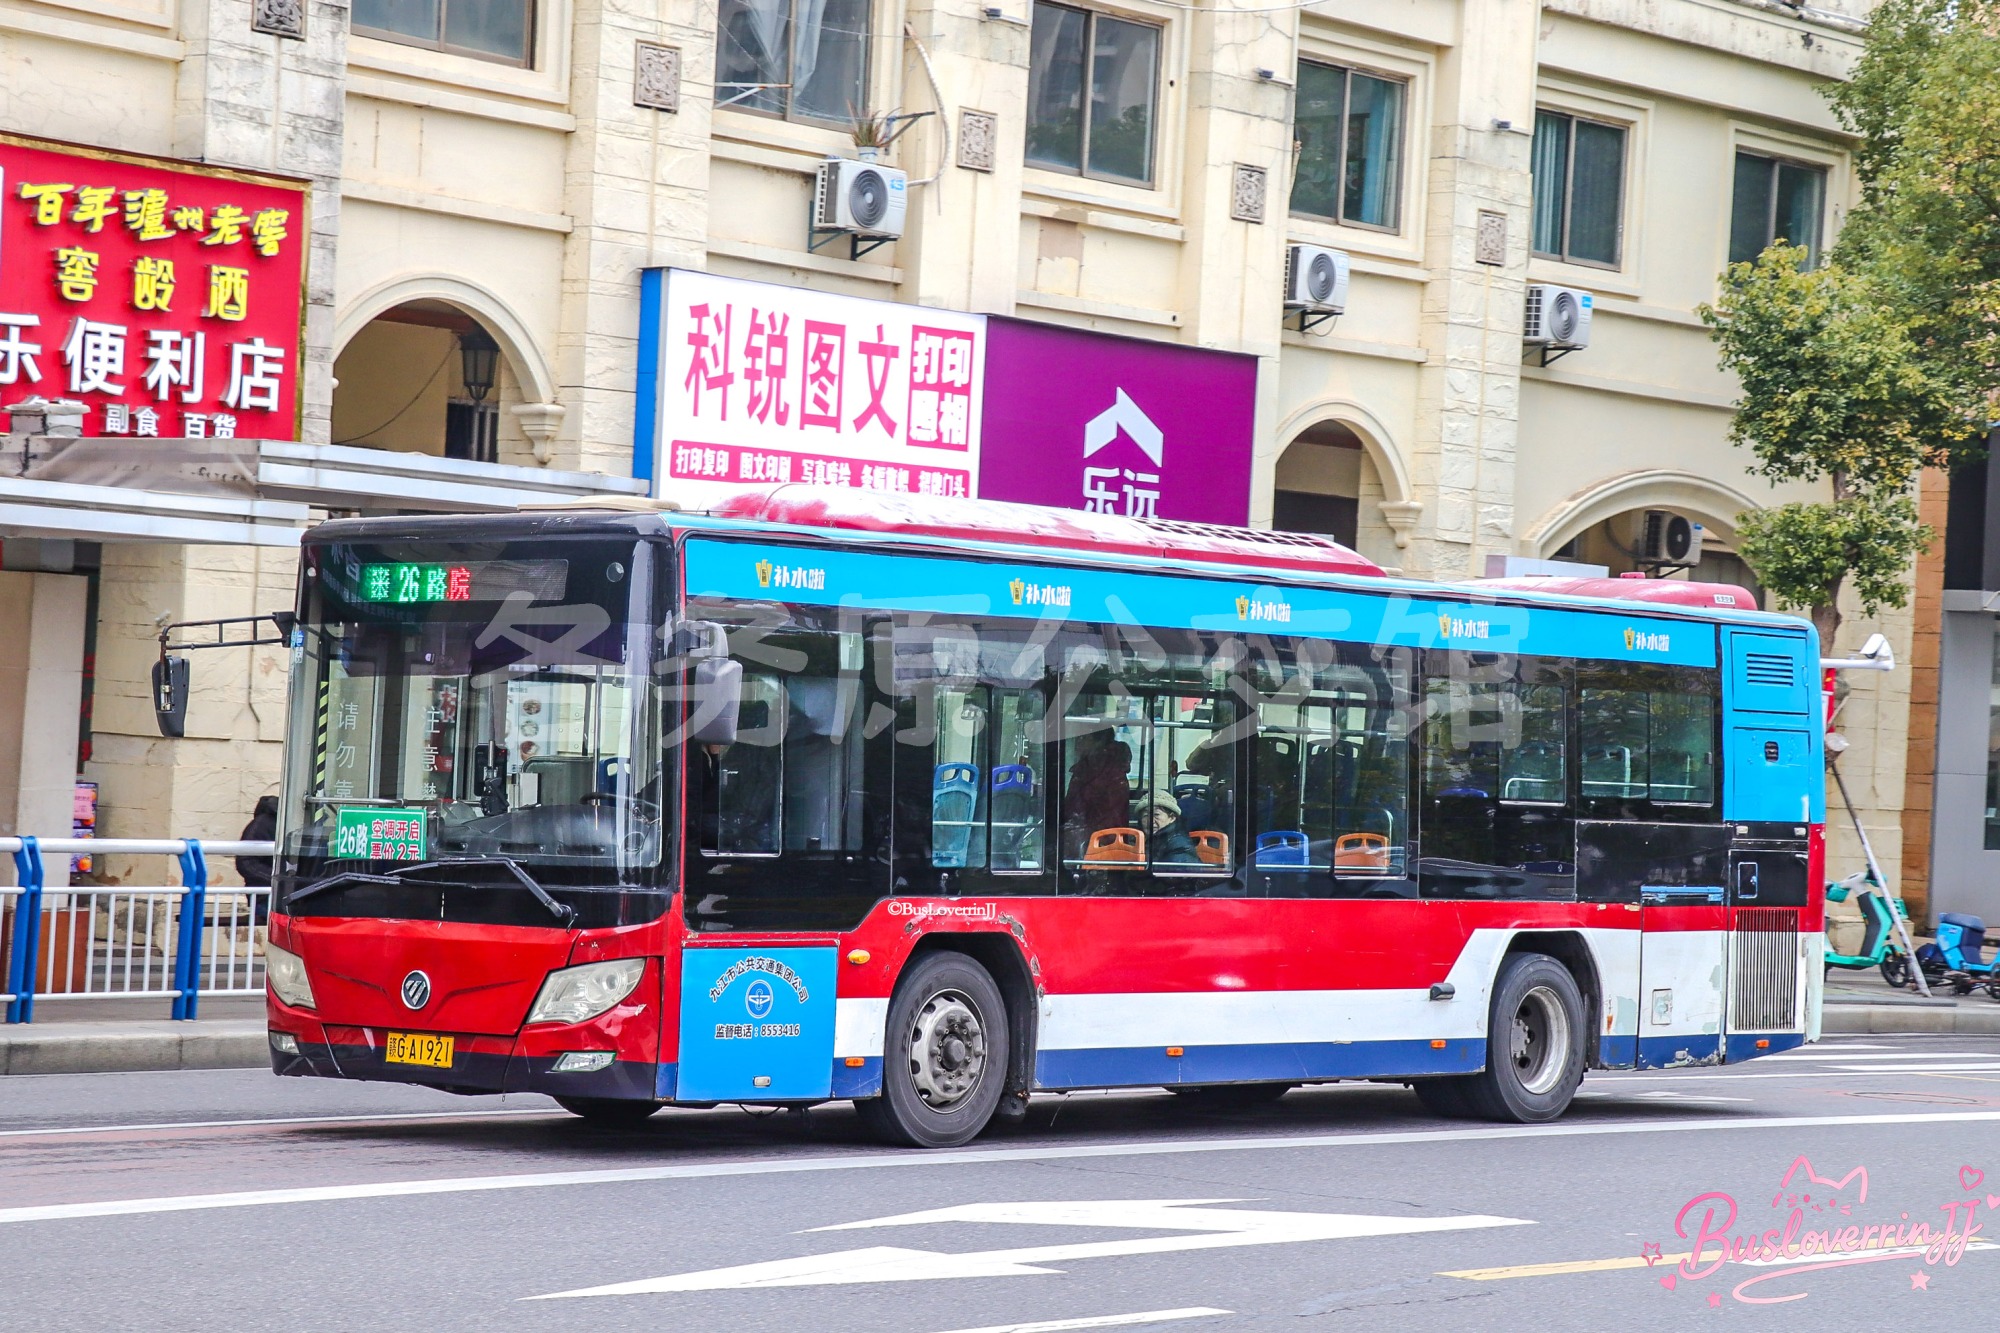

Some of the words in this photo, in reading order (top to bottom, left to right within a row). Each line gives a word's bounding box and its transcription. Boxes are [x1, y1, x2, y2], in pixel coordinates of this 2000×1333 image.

[56, 246, 249, 322] 窖龄酒
[0, 312, 285, 413] 乐便利店
[684, 302, 899, 438] 科锐图文
[913, 332, 971, 388] 打印
[106, 403, 160, 437] 副食
[184, 412, 238, 439] 百货
[676, 445, 729, 477] 打印复印
[739, 451, 791, 483] 图文印刷
[1083, 466, 1160, 519] 乐远
[773, 564, 825, 591] 补水啦
[1025, 582, 1072, 607] 补水啦
[1249, 600, 1291, 623] 补水啦
[1451, 618, 1489, 640] 补水啦
[1635, 631, 1670, 653] 补水啦
[340, 823, 368, 858] 26路
[371, 819, 420, 841] 空调开启
[370, 842, 420, 860] 票价2元
[709, 956, 810, 1004] 九江市公共交通集团公司
